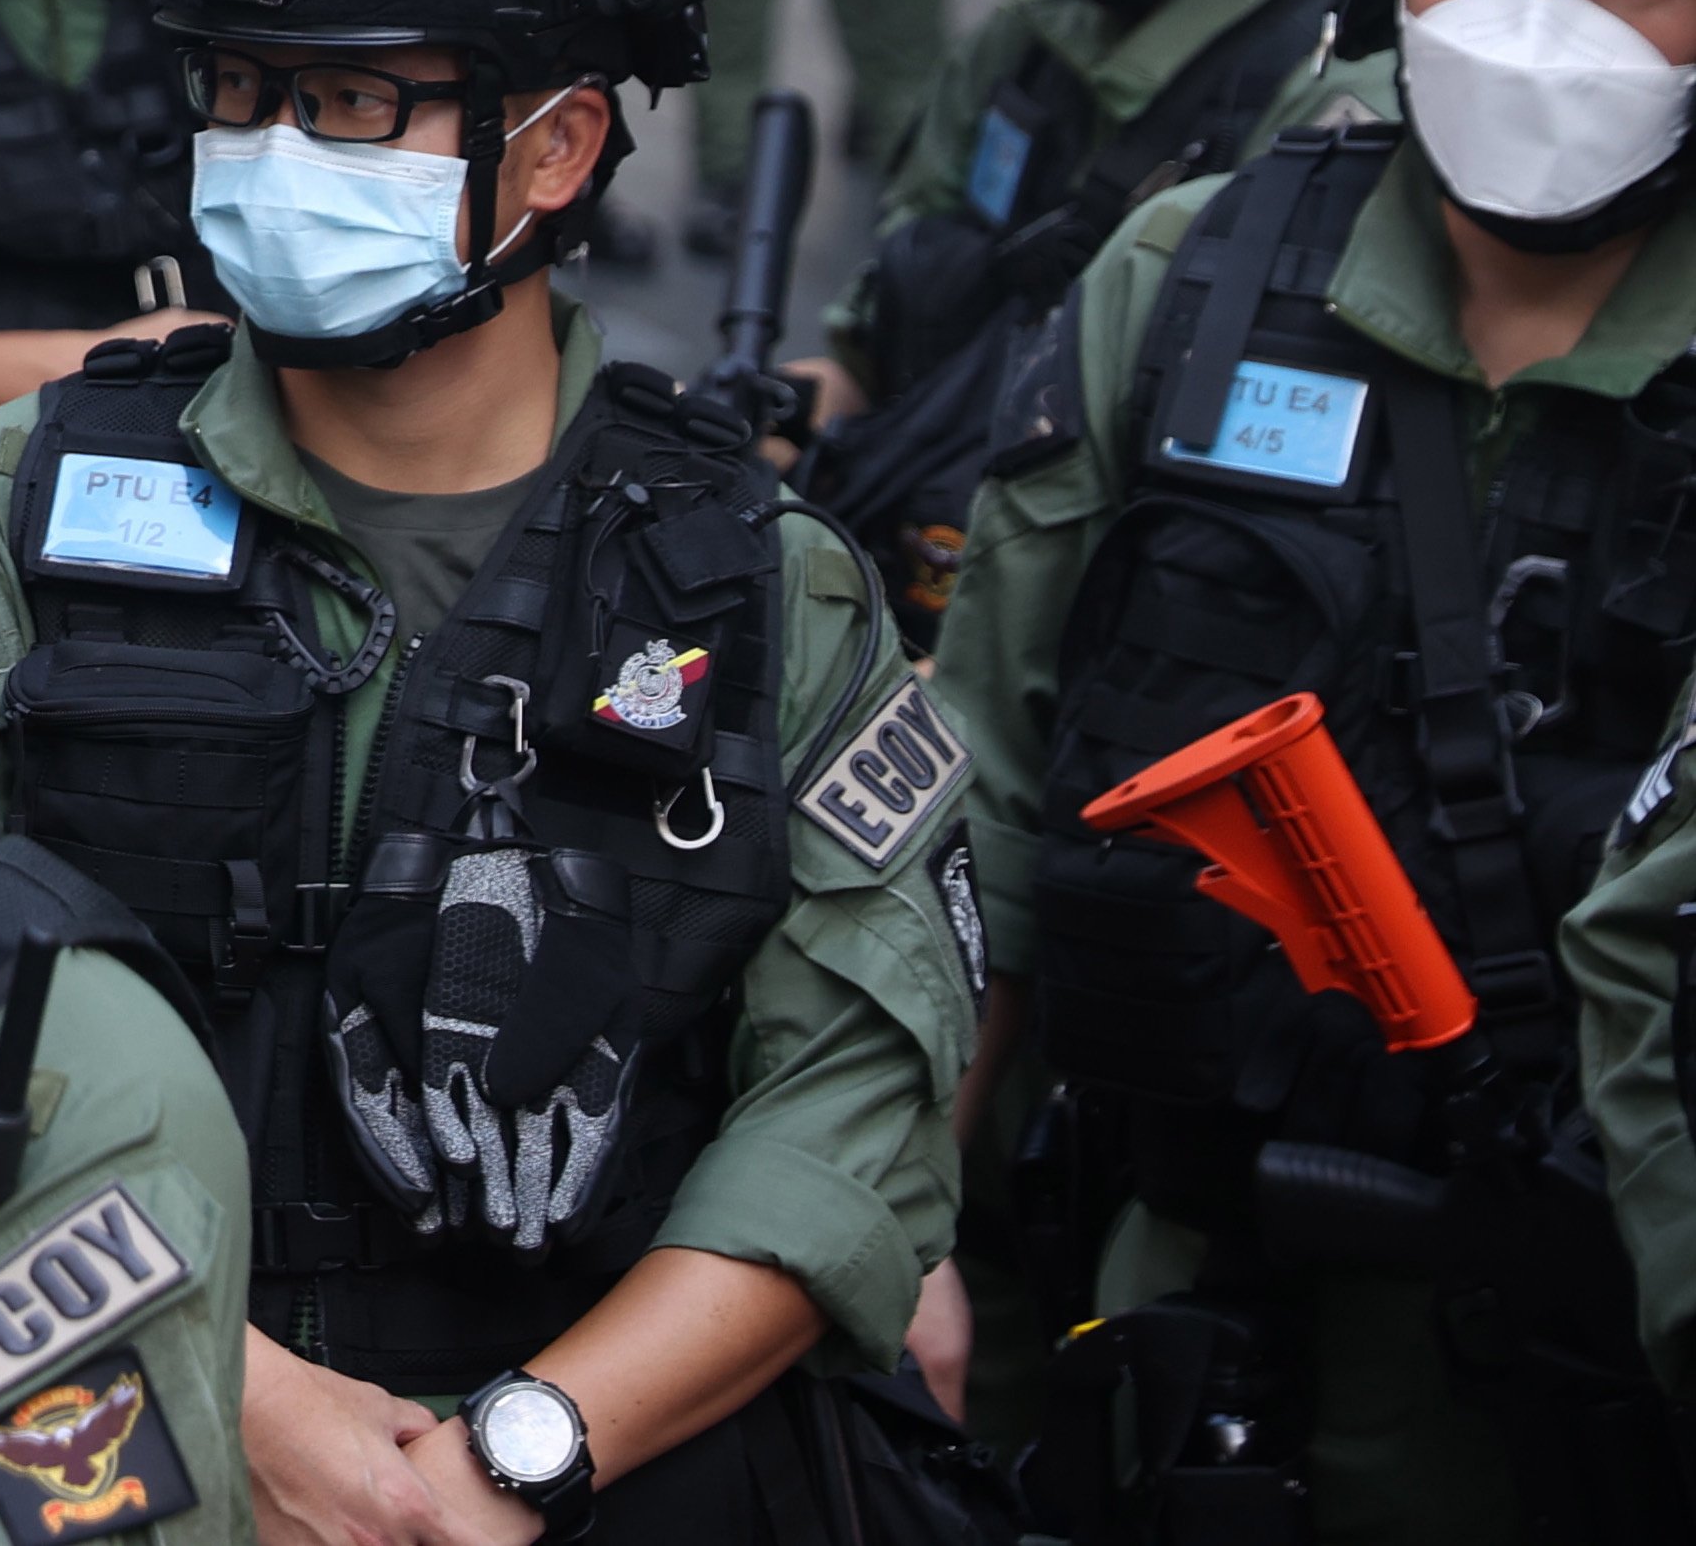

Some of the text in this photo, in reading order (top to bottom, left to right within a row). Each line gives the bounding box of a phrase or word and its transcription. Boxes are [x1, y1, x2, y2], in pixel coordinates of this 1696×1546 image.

[1232, 377, 1331, 415] TU E4
[1234, 425, 1285, 454] 4/5
[86, 472, 213, 509] PTU E4
[118, 518, 167, 547] 1/2
[817, 689, 956, 849] E COY
